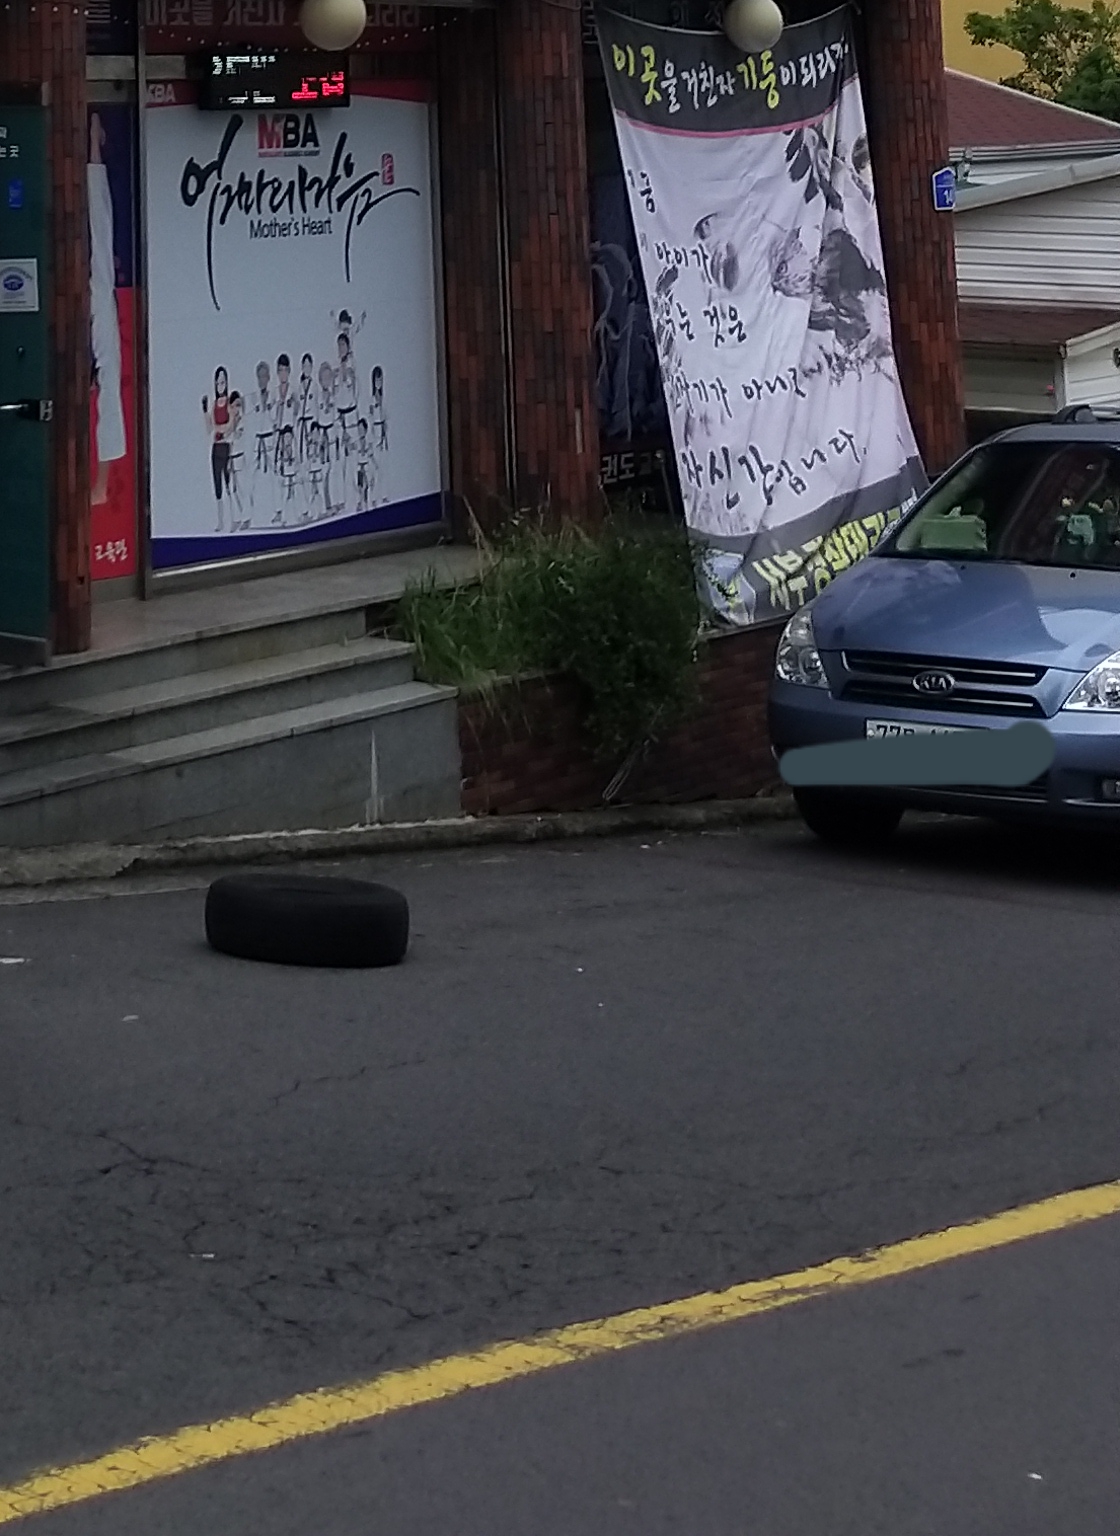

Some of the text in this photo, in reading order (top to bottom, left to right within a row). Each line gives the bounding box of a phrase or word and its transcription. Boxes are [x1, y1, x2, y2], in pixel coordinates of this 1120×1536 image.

[257, 112, 320, 149] MBA
[250, 215, 333, 240] Mother's Heart
[919, 676, 947, 690] KIA
